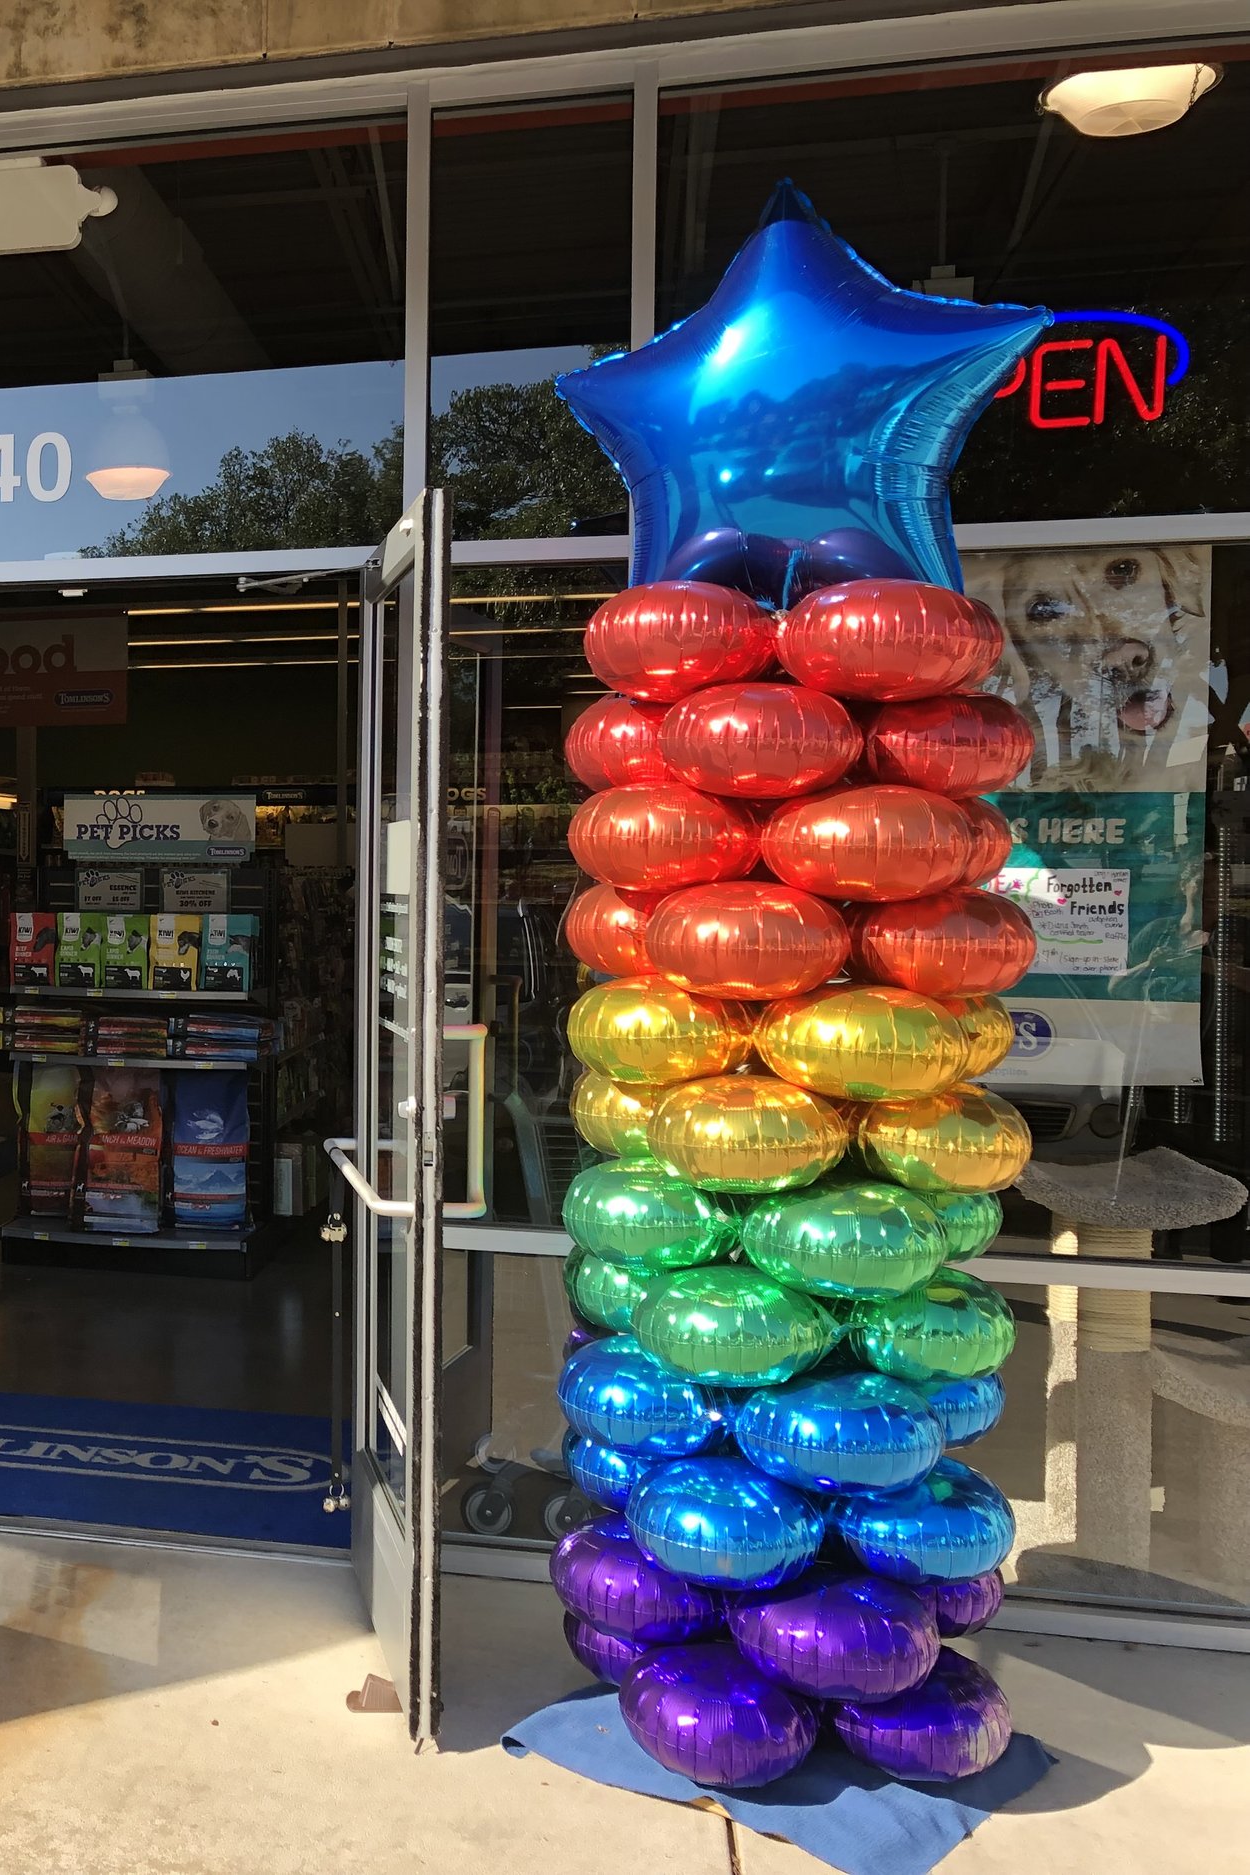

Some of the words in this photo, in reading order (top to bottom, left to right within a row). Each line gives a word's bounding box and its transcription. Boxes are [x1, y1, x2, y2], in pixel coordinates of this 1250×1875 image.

[993, 335, 1167, 428] EN
[446, 786, 488, 801] OGS
[76, 823, 114, 841] PET
[118, 823, 181, 841] PICKS
[1038, 817, 1126, 845] HERE
[1047, 874, 1113, 899] Forgotten
[1070, 900, 1125, 917] Friends
